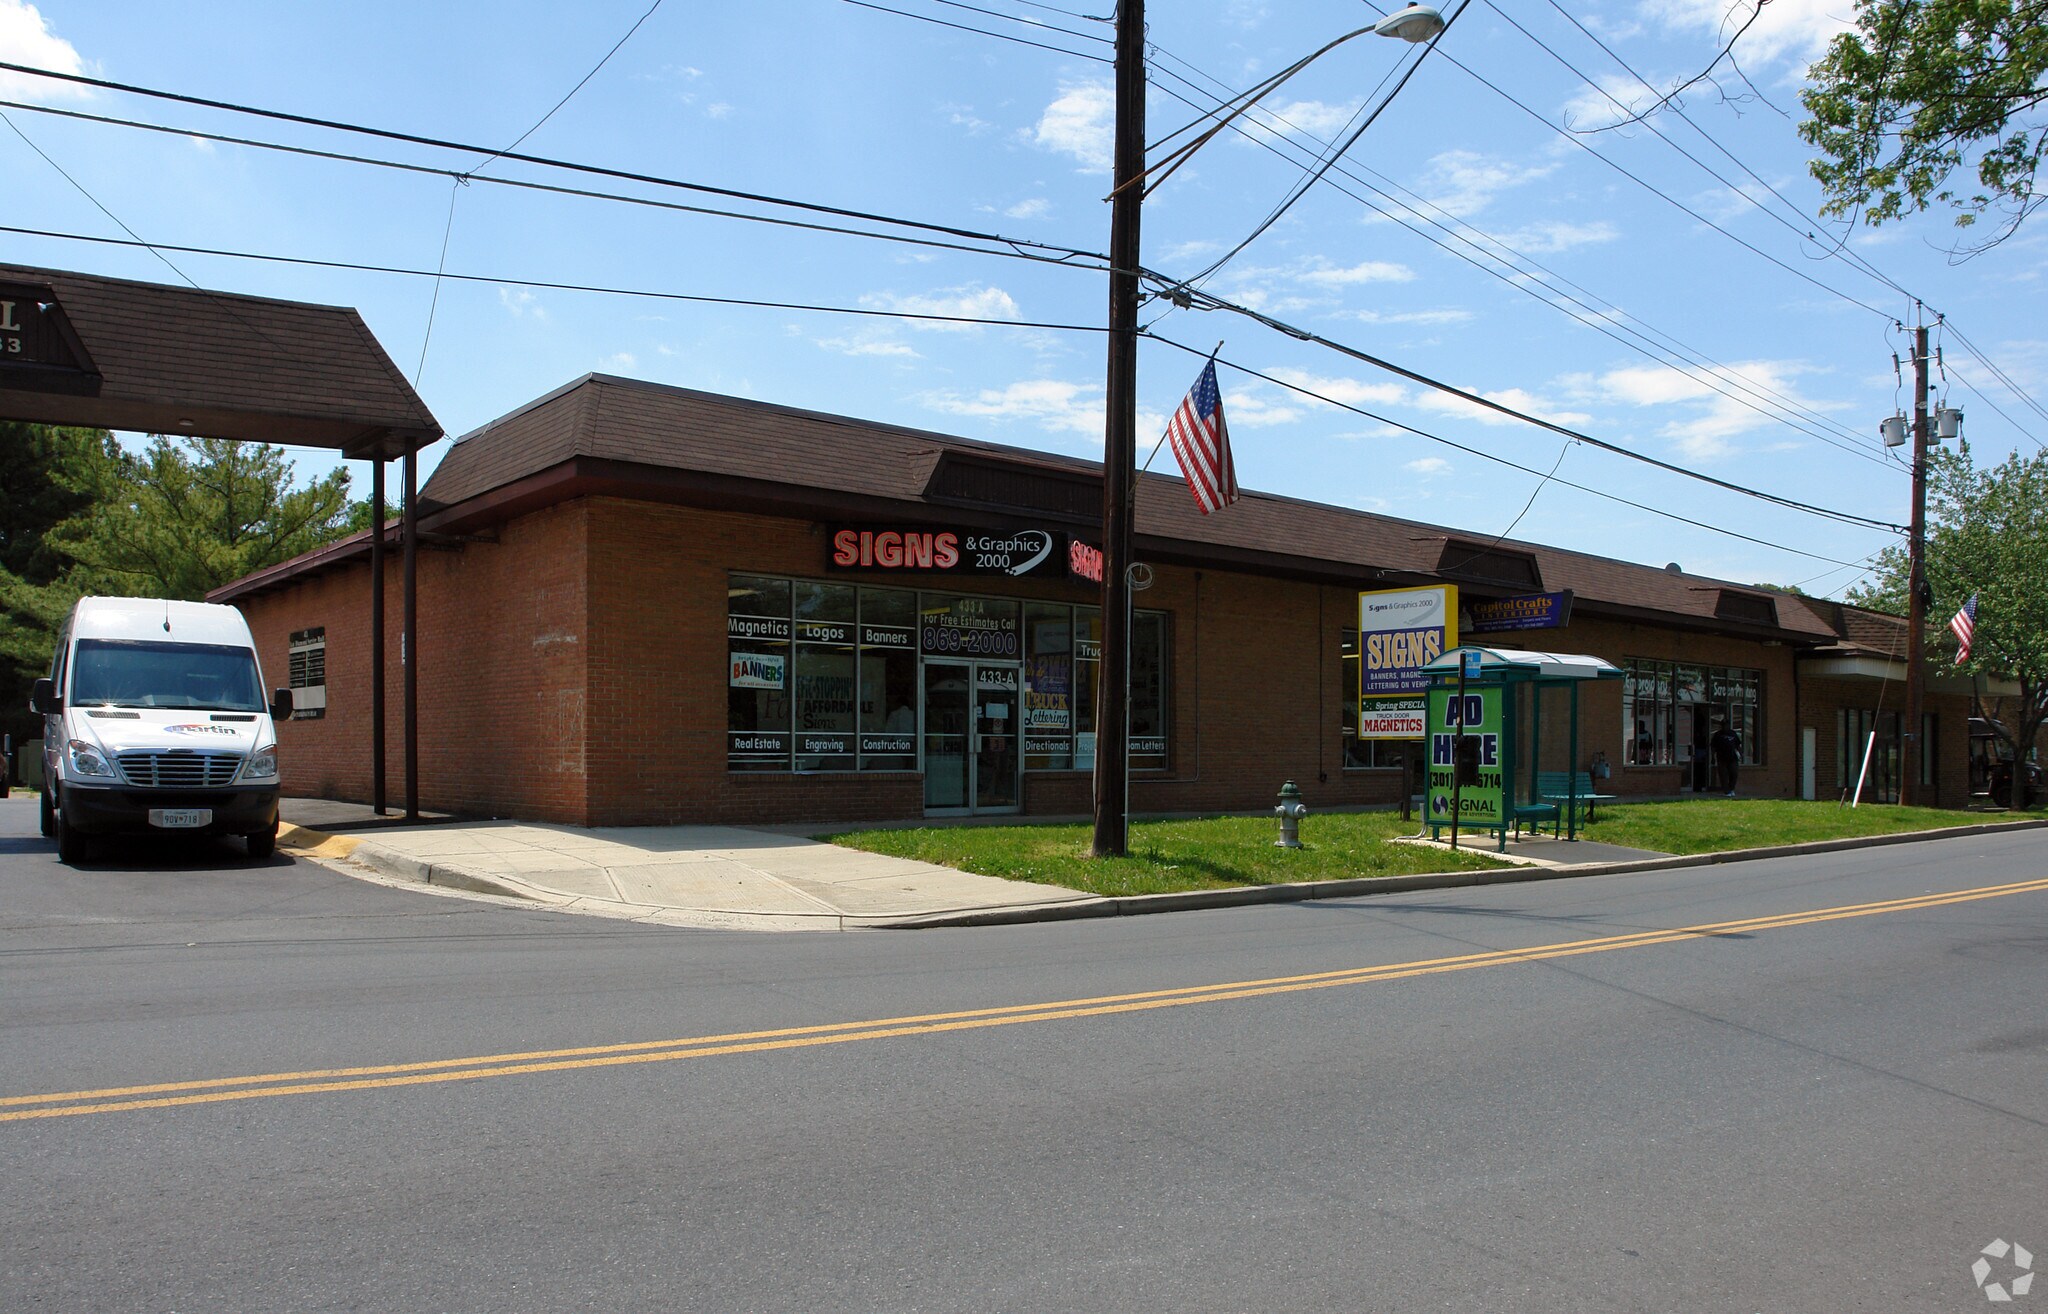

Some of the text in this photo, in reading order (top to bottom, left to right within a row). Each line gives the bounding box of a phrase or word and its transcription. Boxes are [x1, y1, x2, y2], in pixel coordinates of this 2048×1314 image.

[0, 337, 22, 353] 3
[834, 530, 960, 568] SIGNS
[966, 537, 1041, 556] & Graphics
[975, 553, 1011, 569] 2000
[958, 600, 984, 614] 433 A
[1394, 600, 1418, 610] Graphics
[1516, 597, 1553, 609] Crafts
[728, 618, 789, 636] Magnetics
[924, 614, 1016, 630] For Free Estimates Call
[806, 624, 845, 641] Logos
[866, 629, 908, 644] Banners
[923, 626, 1017, 655] 869-2000
[1081, 644, 1101, 657] Truc
[1367, 630, 1440, 670] SIGNS
[733, 661, 783, 682] BANNERS
[979, 670, 1015, 685] 433-A
[1370, 672, 1399, 681] BANNERS,
[1367, 682, 1399, 690] LETTERING
[803, 700, 874, 714] AFFORDALE
[1025, 690, 1068, 710] TRUCK
[1376, 700, 1425, 711] Spring SPECIA
[1024, 704, 1068, 728] Lettering
[1364, 719, 1423, 732] MAGNETICS
[735, 738, 781, 750] Real Estate
[805, 739, 844, 752] Engraving
[863, 739, 911, 750] Construction
[1026, 740, 1069, 751] Directionals
[1142, 741, 1164, 750] Letters
[1430, 772, 1454, 790] (301)
